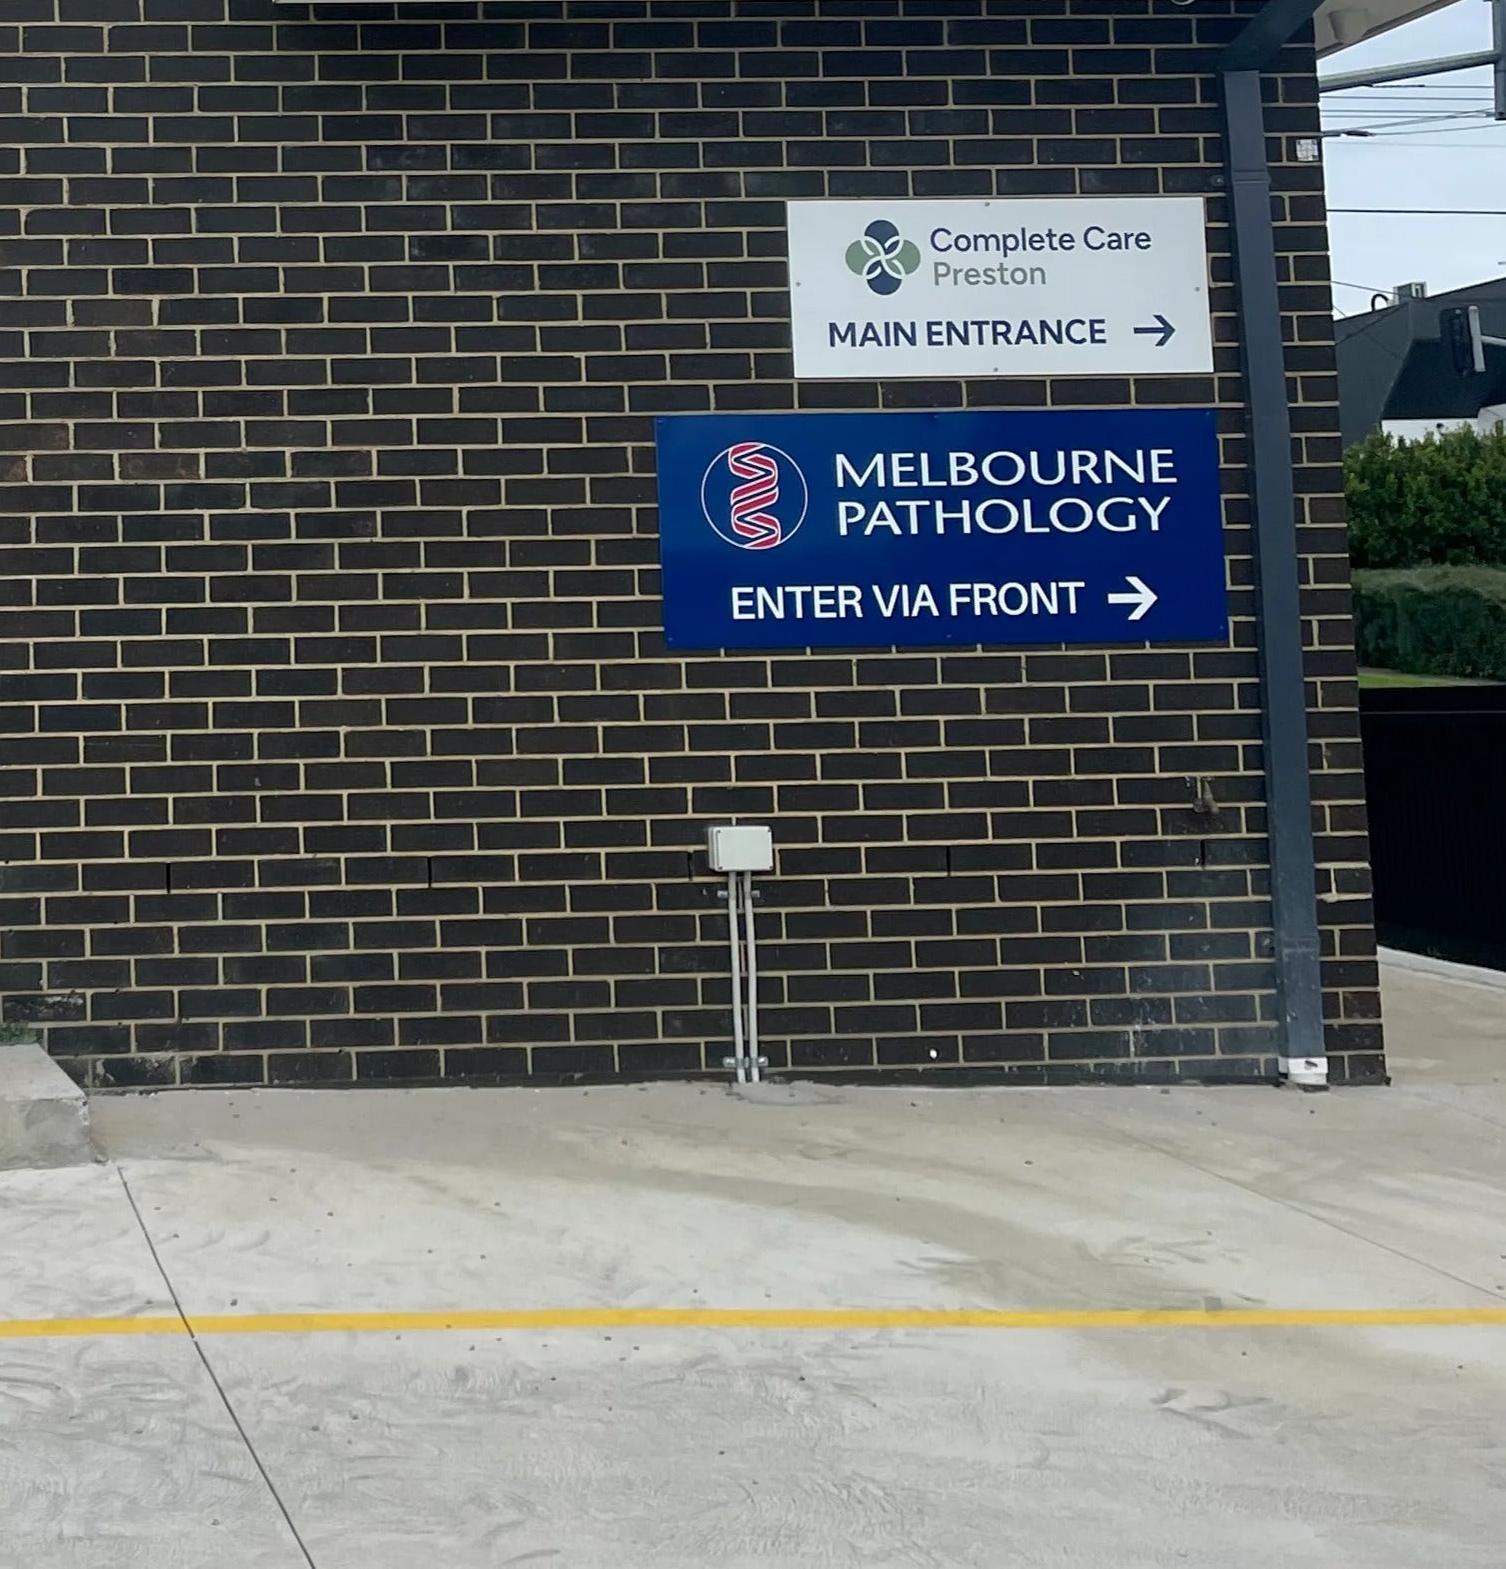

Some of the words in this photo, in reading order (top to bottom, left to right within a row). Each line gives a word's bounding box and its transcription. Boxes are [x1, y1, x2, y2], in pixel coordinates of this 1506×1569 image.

[930, 226, 1076, 258] Complete
[1083, 225, 1152, 251] Care
[933, 261, 1047, 286] Preston
[828, 321, 917, 348] MAIN
[926, 318, 1107, 347] ENTRANCE
[835, 448, 1178, 488] MELBOURNE
[838, 496, 1171, 536] PATHOLOGY
[731, 585, 863, 620] ENTER
[871, 583, 940, 618] VIA
[949, 581, 1086, 616] FRONT
